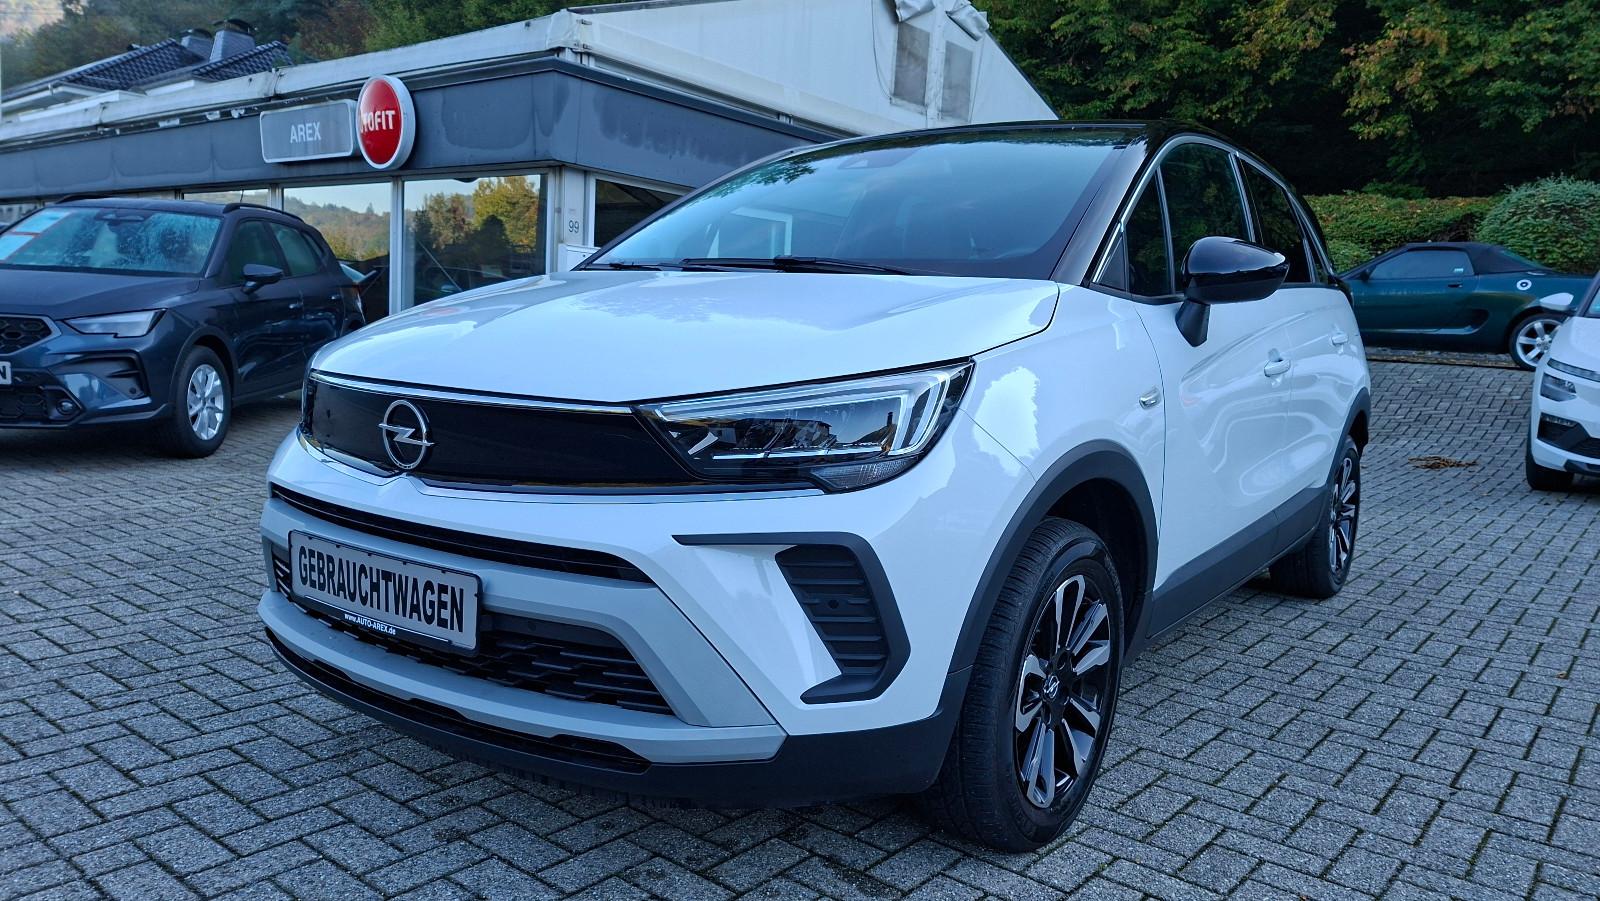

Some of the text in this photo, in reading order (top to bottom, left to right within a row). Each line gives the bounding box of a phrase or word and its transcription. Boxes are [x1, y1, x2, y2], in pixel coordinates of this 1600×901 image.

[290, 121, 321, 143] AREX
[568, 220, 579, 233] 99
[298, 545, 464, 632] GEBRAUCHTWAGEN
[344, 613, 396, 635] www.AUTO-AREX.de
